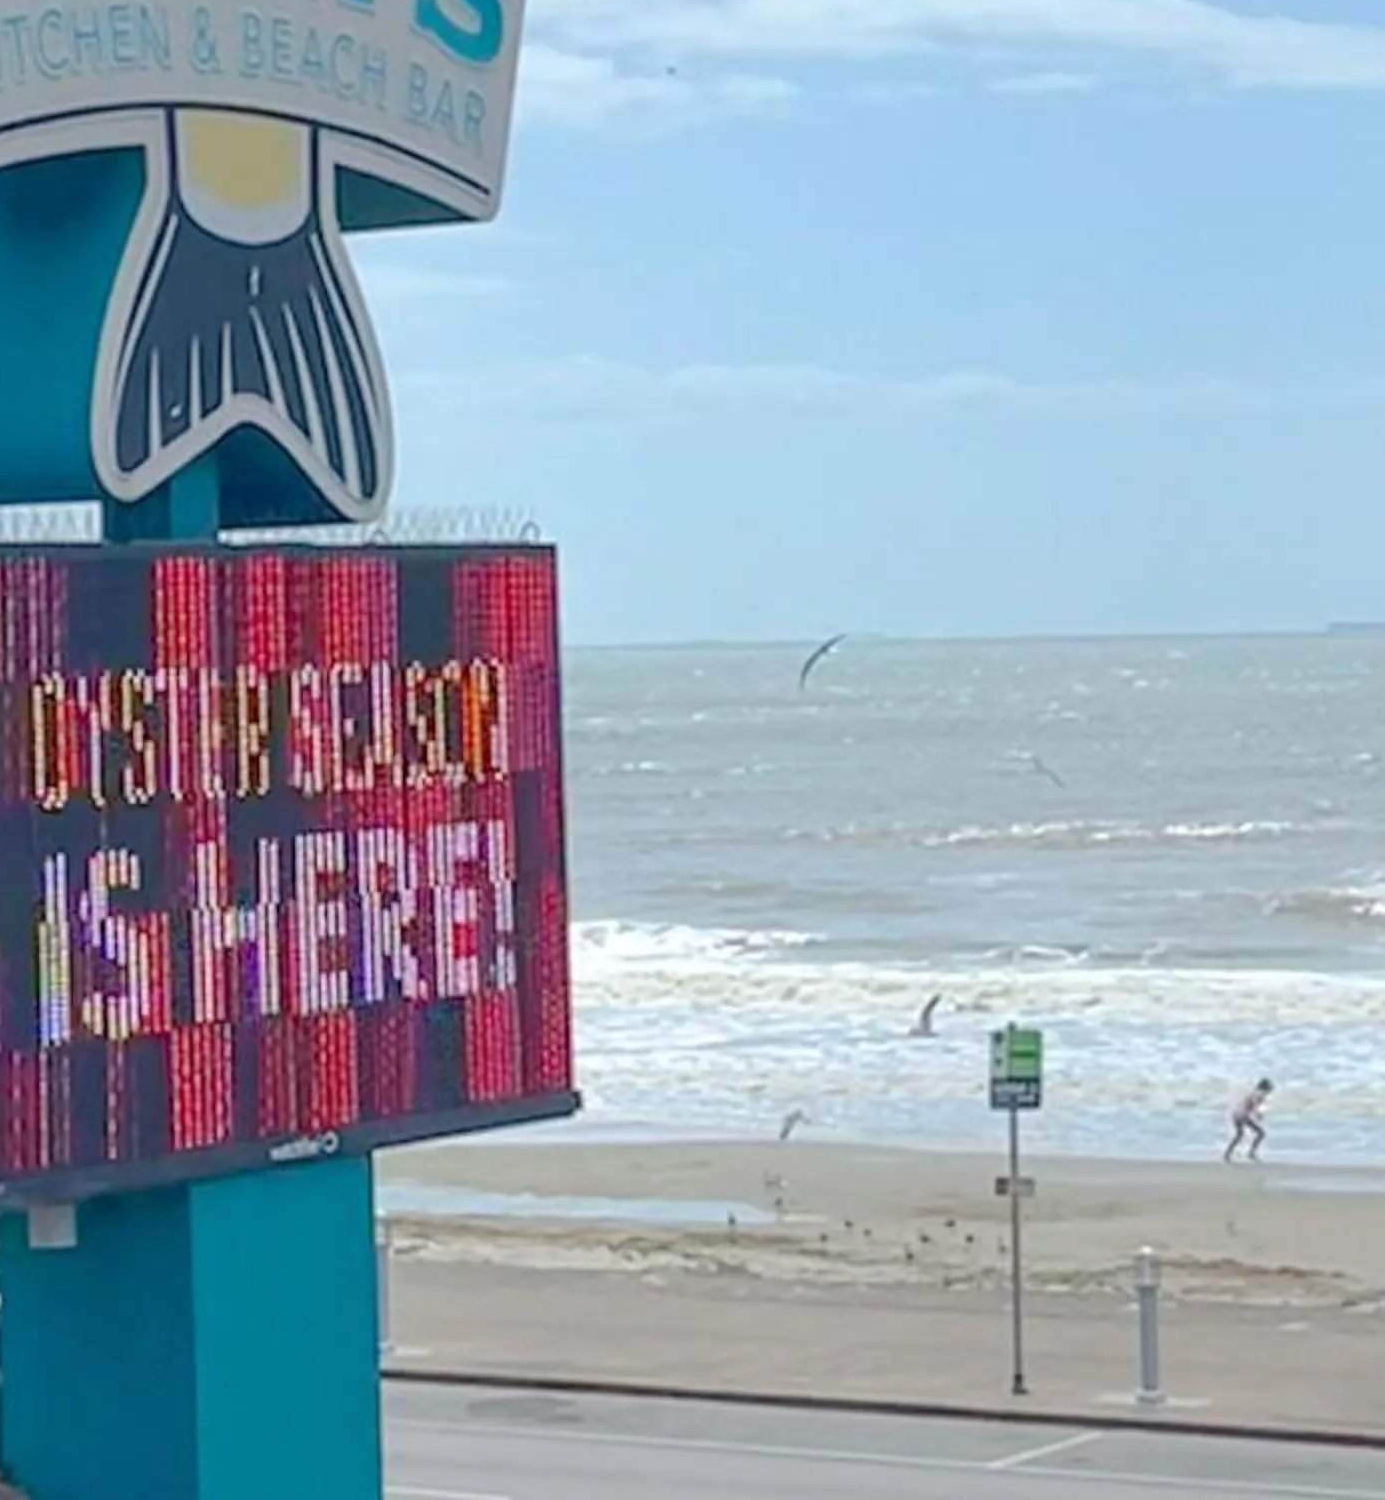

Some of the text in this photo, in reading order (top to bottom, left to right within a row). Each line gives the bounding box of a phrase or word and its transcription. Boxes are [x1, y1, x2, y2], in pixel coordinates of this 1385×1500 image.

[191, 6, 220, 70] &
[240, 11, 389, 102] BEACH
[406, 62, 488, 145] BAR
[38, 819, 516, 1047] IS HERE!
